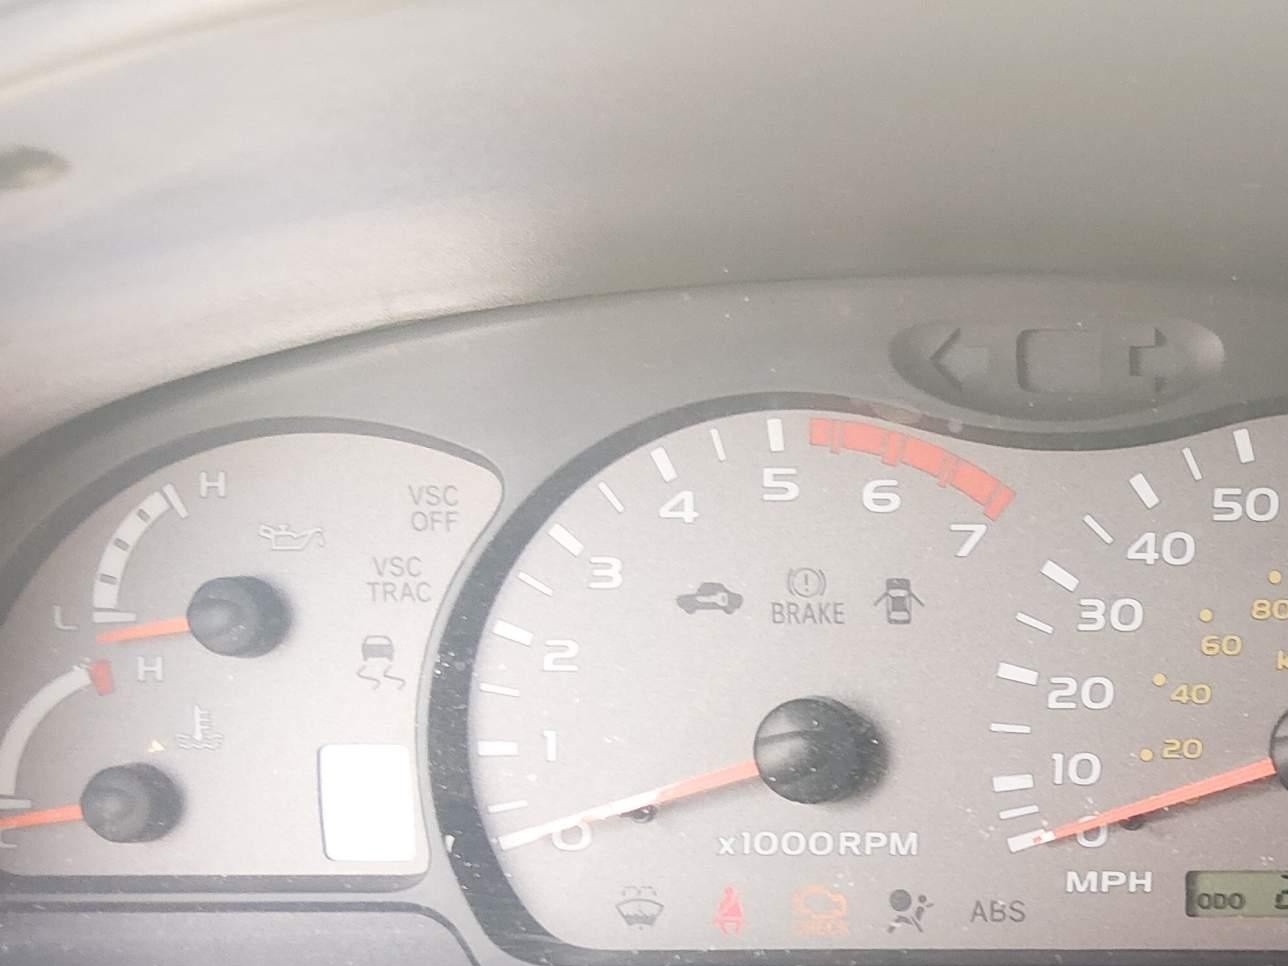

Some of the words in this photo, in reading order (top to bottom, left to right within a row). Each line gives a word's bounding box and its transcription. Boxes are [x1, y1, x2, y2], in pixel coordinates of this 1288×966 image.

[200, 472, 226, 497] H
[408, 485, 458, 507] VSC
[762, 468, 801, 502] 5
[862, 479, 901, 513] 6
[658, 490, 699, 523] 4
[1212, 487, 1280, 523] 50
[412, 510, 458, 532] OFF
[949, 523, 987, 557] 7
[1126, 531, 1195, 567] 40
[372, 557, 422, 577] VSC
[588, 556, 624, 590] 3
[366, 581, 432, 603] TRAC
[53, 605, 79, 632] L
[771, 601, 845, 625] BRAKE
[1076, 598, 1145, 633] 30
[542, 639, 580, 672] 2
[1200, 635, 1242, 656] 60
[137, 656, 163, 681] H
[1046, 676, 1114, 710] 20
[1170, 683, 1212, 705] 40
[543, 730, 558, 761] 1
[1161, 738, 1203, 760] 20
[1051, 752, 1101, 787] 10
[1065, 871, 1152, 893] MPH
[970, 900, 1026, 923] ABS
[1198, 893, 1246, 910] ODO
